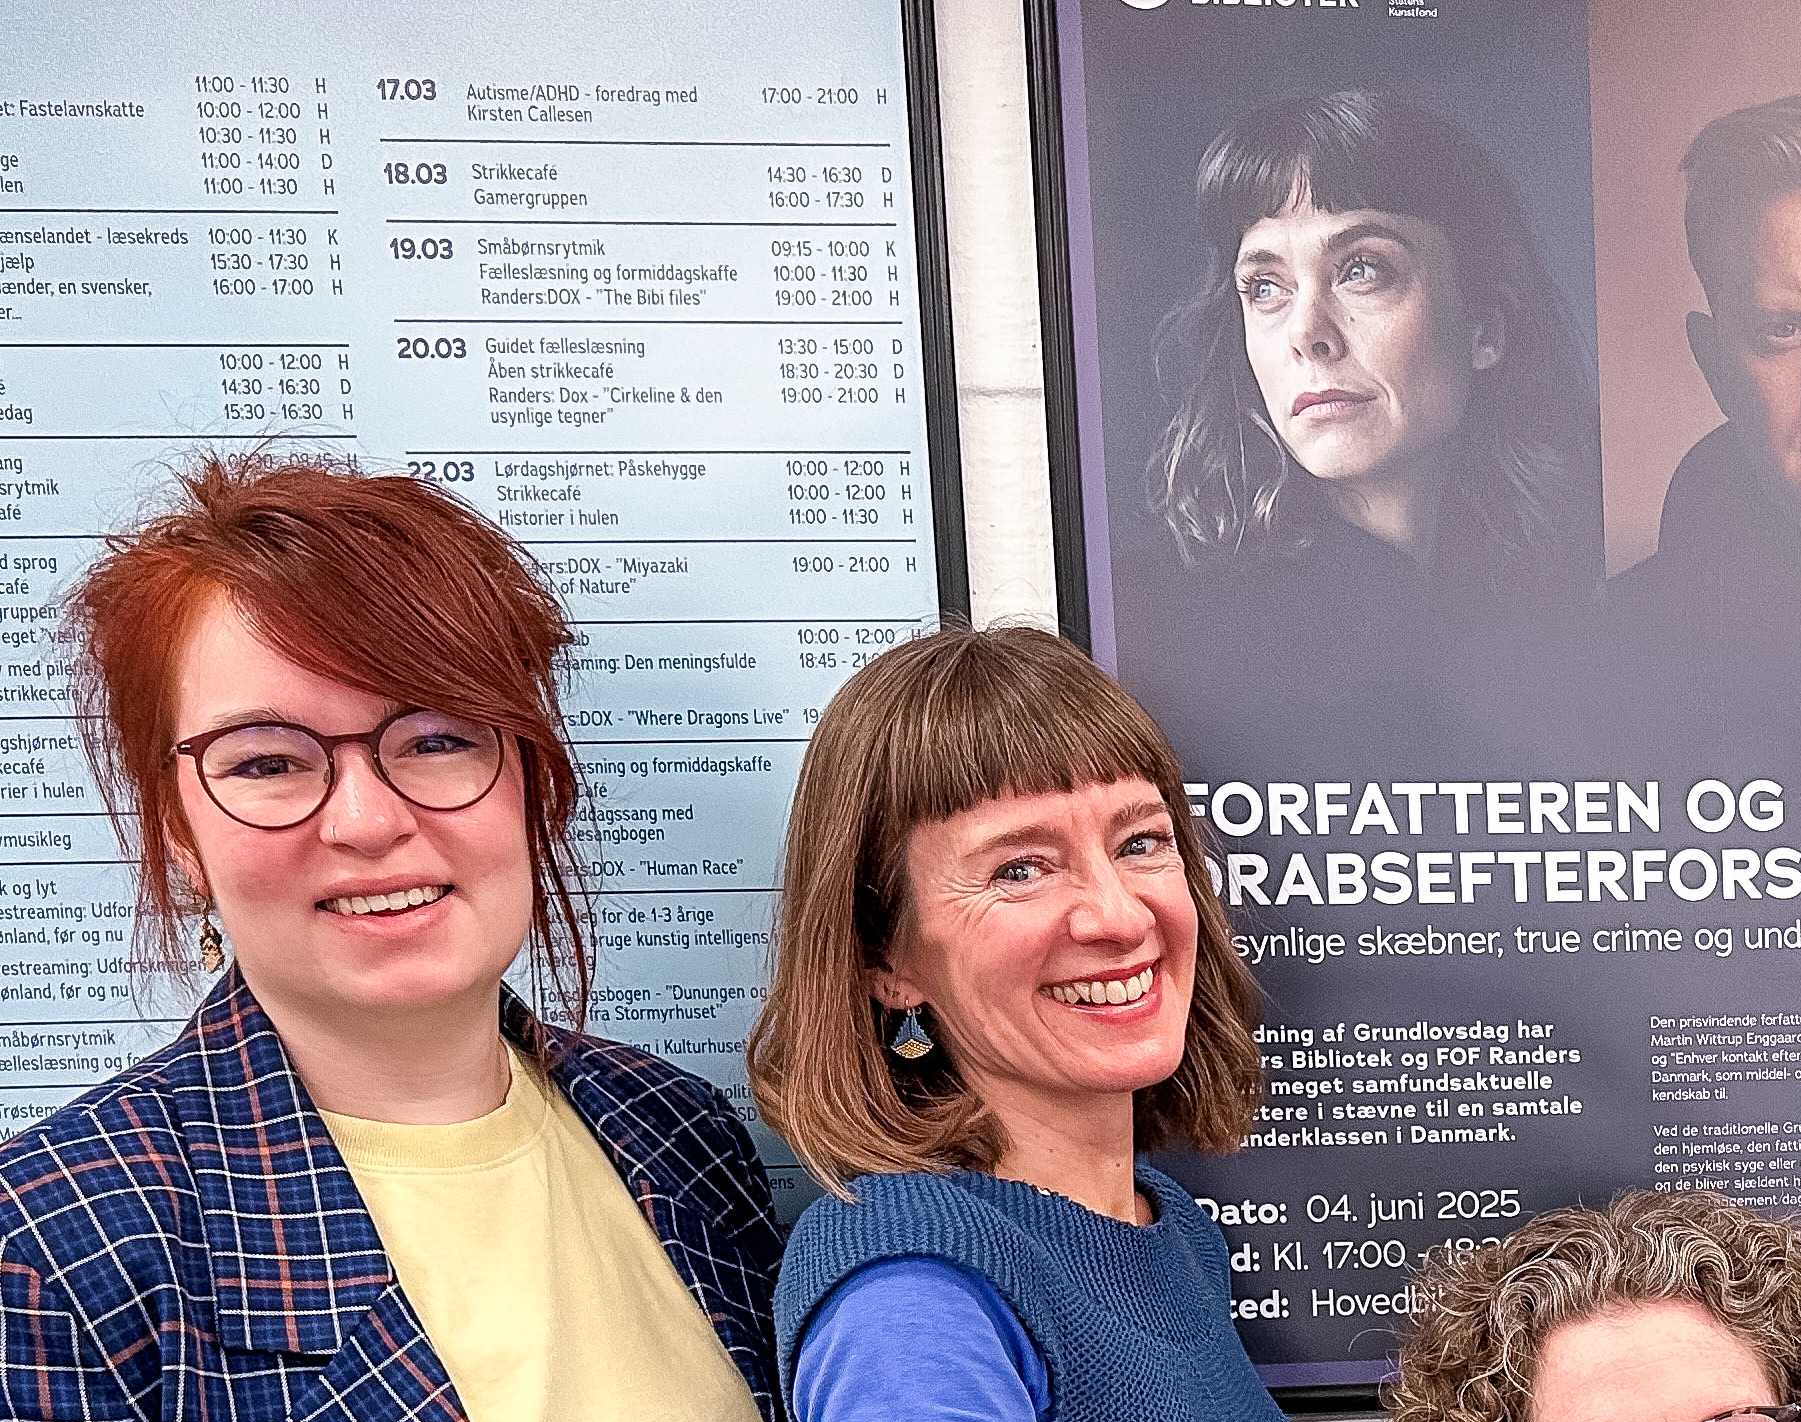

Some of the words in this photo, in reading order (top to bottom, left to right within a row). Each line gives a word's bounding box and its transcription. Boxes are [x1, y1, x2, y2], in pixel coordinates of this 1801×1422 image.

[375, 78, 437, 101] 17.03
[466, 83, 580, 105] Autisme/ADHD
[595, 84, 661, 107] foredrag
[665, 85, 698, 104] med
[761, 87, 802, 105] 17:00
[816, 87, 859, 105] 21:00
[876, 87, 888, 106] H
[19, 99, 145, 118] Fastelavnskatte
[467, 104, 523, 122] Kirsten
[527, 104, 593, 123] Callesen
[383, 162, 448, 185] 18.03
[471, 162, 558, 181] Strikkecafé
[473, 188, 588, 210] Gamergruppen
[106, 227, 190, 246] læsekreds
[389, 237, 454, 260] 19.03
[477, 236, 606, 260] Småbørnsrytmik
[479, 262, 589, 285] Fælleslæsning
[593, 268, 612, 285] og
[616, 263, 738, 285] formiddagskaffe
[481, 287, 581, 305] Randers:DOX
[595, 288, 632, 306] "The
[636, 288, 665, 306] Bibi
[668, 288, 707, 306] files"
[396, 337, 467, 359] 20.03
[485, 337, 536, 356] Guidet
[539, 336, 645, 359] fælleslæsning
[487, 358, 526, 379] Åben
[530, 361, 614, 380] strikkecafé
[494, 460, 614, 481] Lørdagshjørnet:
[617, 459, 706, 481] Påskehygge
[498, 509, 565, 527] Historier
[569, 509, 575, 527] i
[578, 508, 619, 526] hulen
[627, 709, 683, 726] "Where
[687, 709, 749, 729] Dragons
[753, 708, 790, 725] Live"
[1686, 779, 1784, 833] OG
[1225, 925, 1347, 965] synlige
[1357, 924, 1504, 959] skæbner,
[1513, 925, 1581, 954] true
[1592, 922, 1683, 952] crime
[1694, 928, 1733, 958] og
[59, 982, 82, 1000] før
[87, 985, 106, 1002] og
[110, 985, 130, 999] nu
[589, 1005, 611, 1022] fra
[1650, 1015, 1676, 1029] Den
[1679, 1014, 1758, 1030] prisvindende
[1322, 1022, 1346, 1043] af
[1353, 1020, 1509, 1044] Grundlovsdag
[1517, 1019, 1554, 1039] har
[1291, 1048, 1393, 1069] Bibliotek
[1400, 1052, 1429, 1070] og
[1436, 1046, 1481, 1066] FOF
[1489, 1045, 1581, 1065] Randers
[1270, 1077, 1344, 1097] meget
[1352, 1071, 1553, 1094] samfundsaktuelle
[1652, 1087, 1711, 1102] kendskab
[1317, 1102, 1324, 1120] i
[1332, 1102, 1417, 1120] stævne
[1457, 1102, 1484, 1117] en
[1492, 1096, 1583, 1116] samtale
[1653, 1124, 1678, 1137] Ved
[1681, 1124, 1699, 1137] de
[1702, 1121, 1779, 1136] traditionelle
[1194, 1197, 1288, 1226] Dato:
[1306, 1194, 1358, 1223] 04.
[1367, 1191, 1425, 1229] juni
[1436, 1190, 1521, 1219] 2025
[1273, 1242, 1309, 1271] Kl.
[1322, 1239, 1407, 1270] 17:00
